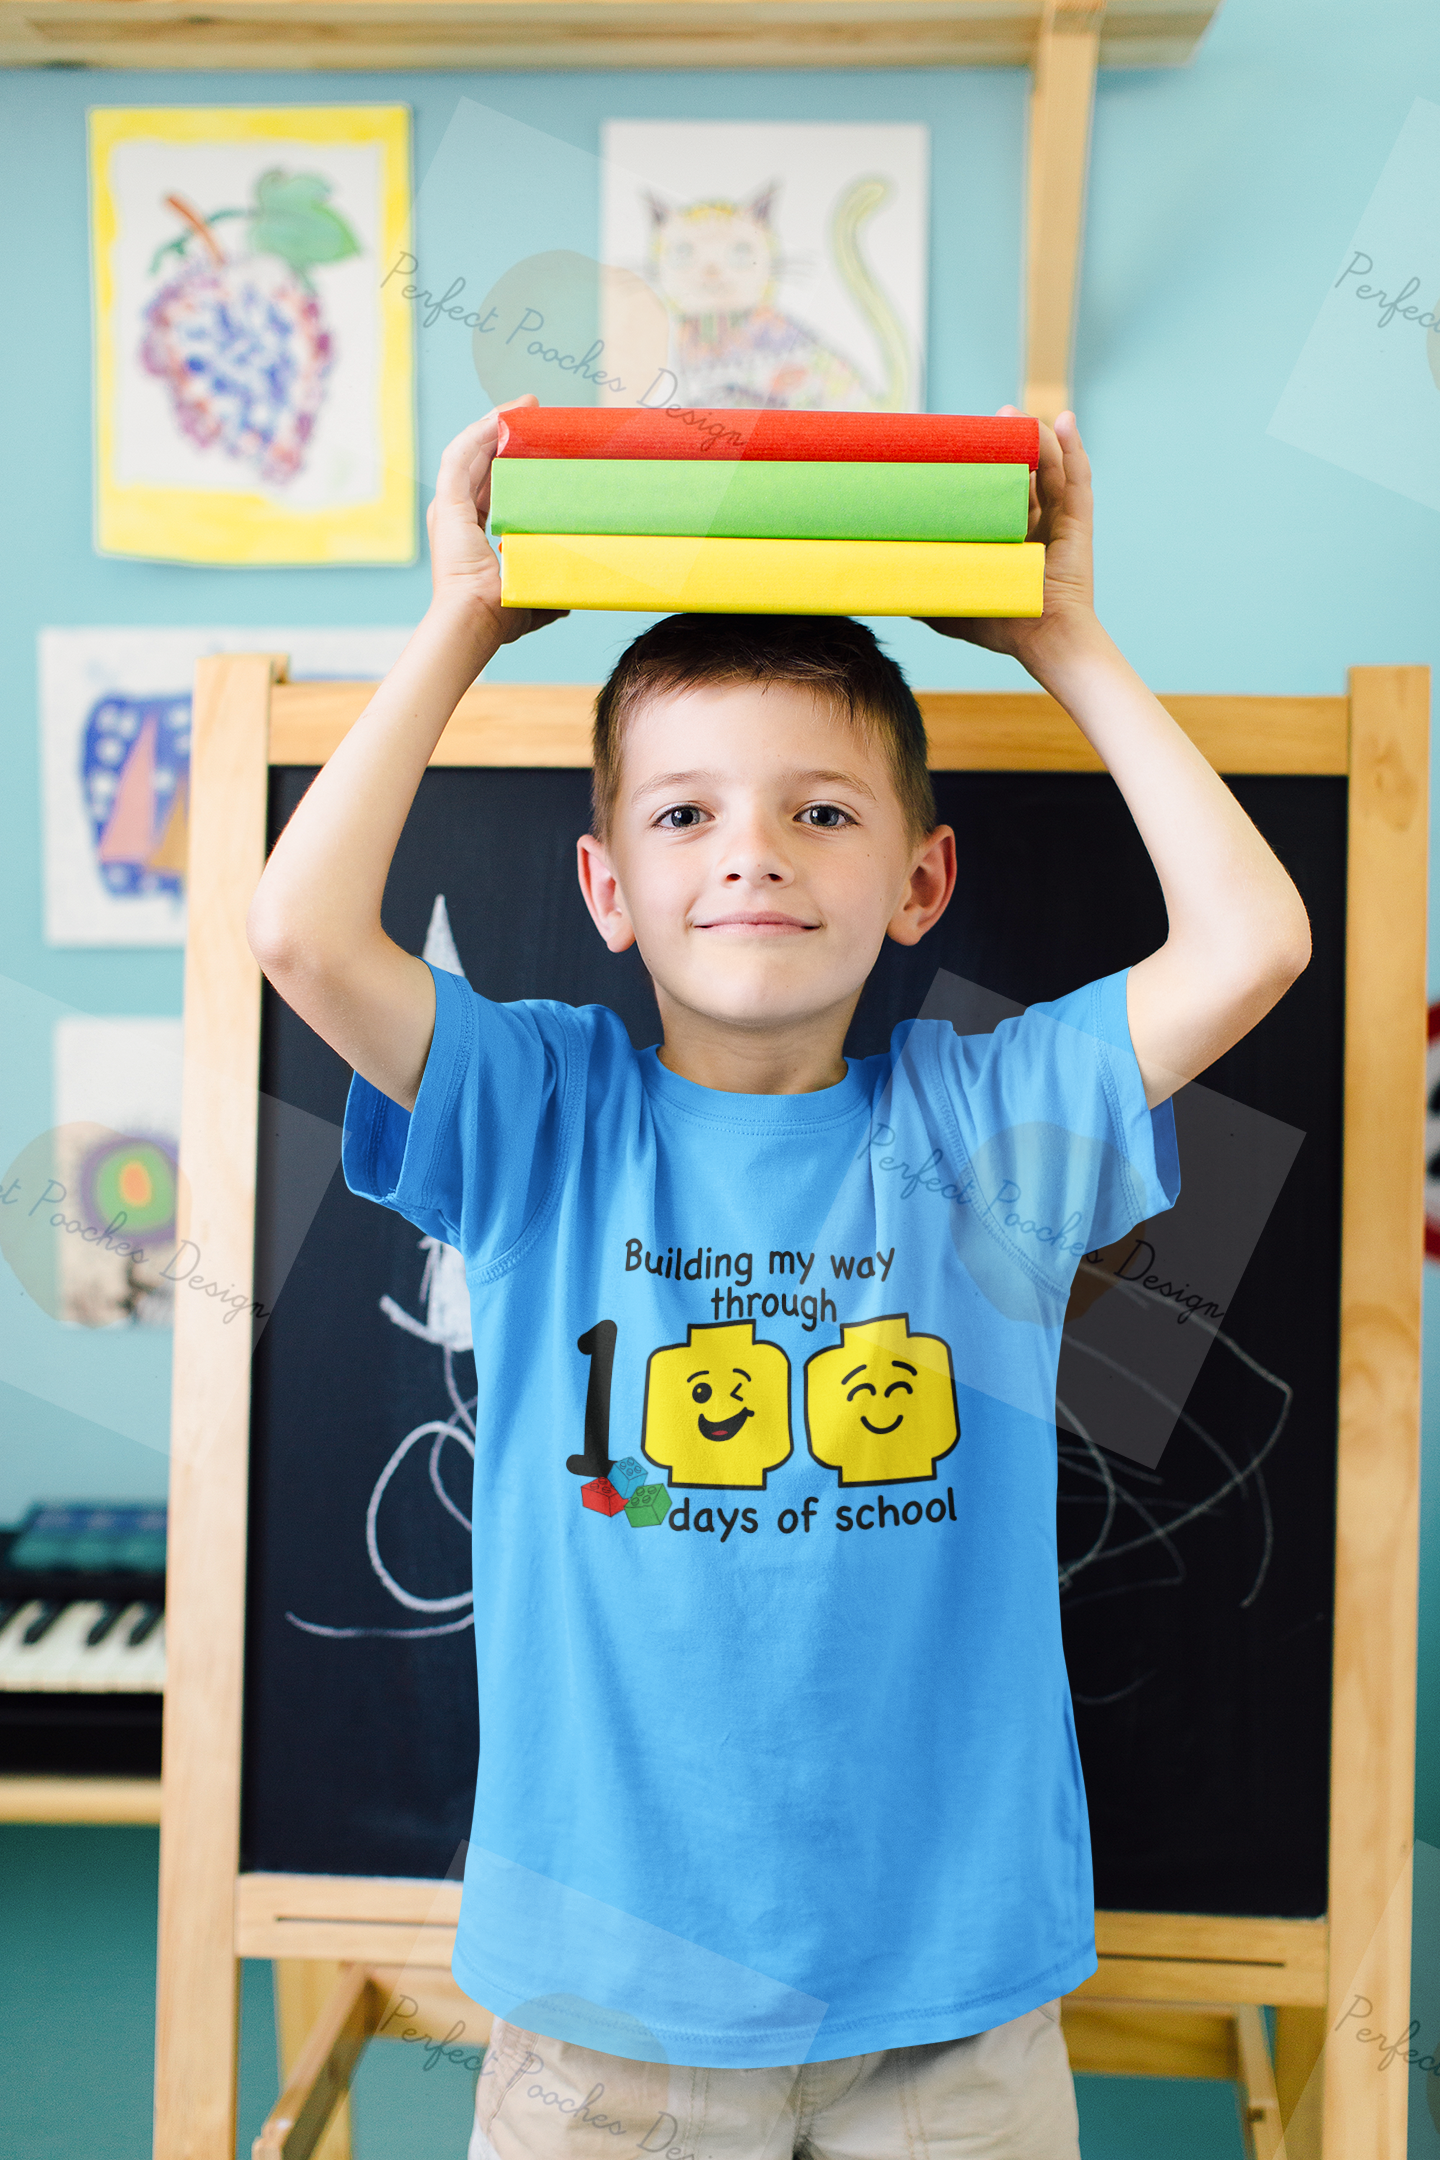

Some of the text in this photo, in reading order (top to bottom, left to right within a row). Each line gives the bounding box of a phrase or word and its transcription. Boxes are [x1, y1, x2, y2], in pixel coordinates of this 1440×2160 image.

[624, 1238, 895, 1286] Building my way
[711, 1286, 837, 1332] through
[668, 1487, 958, 1543] days of school
